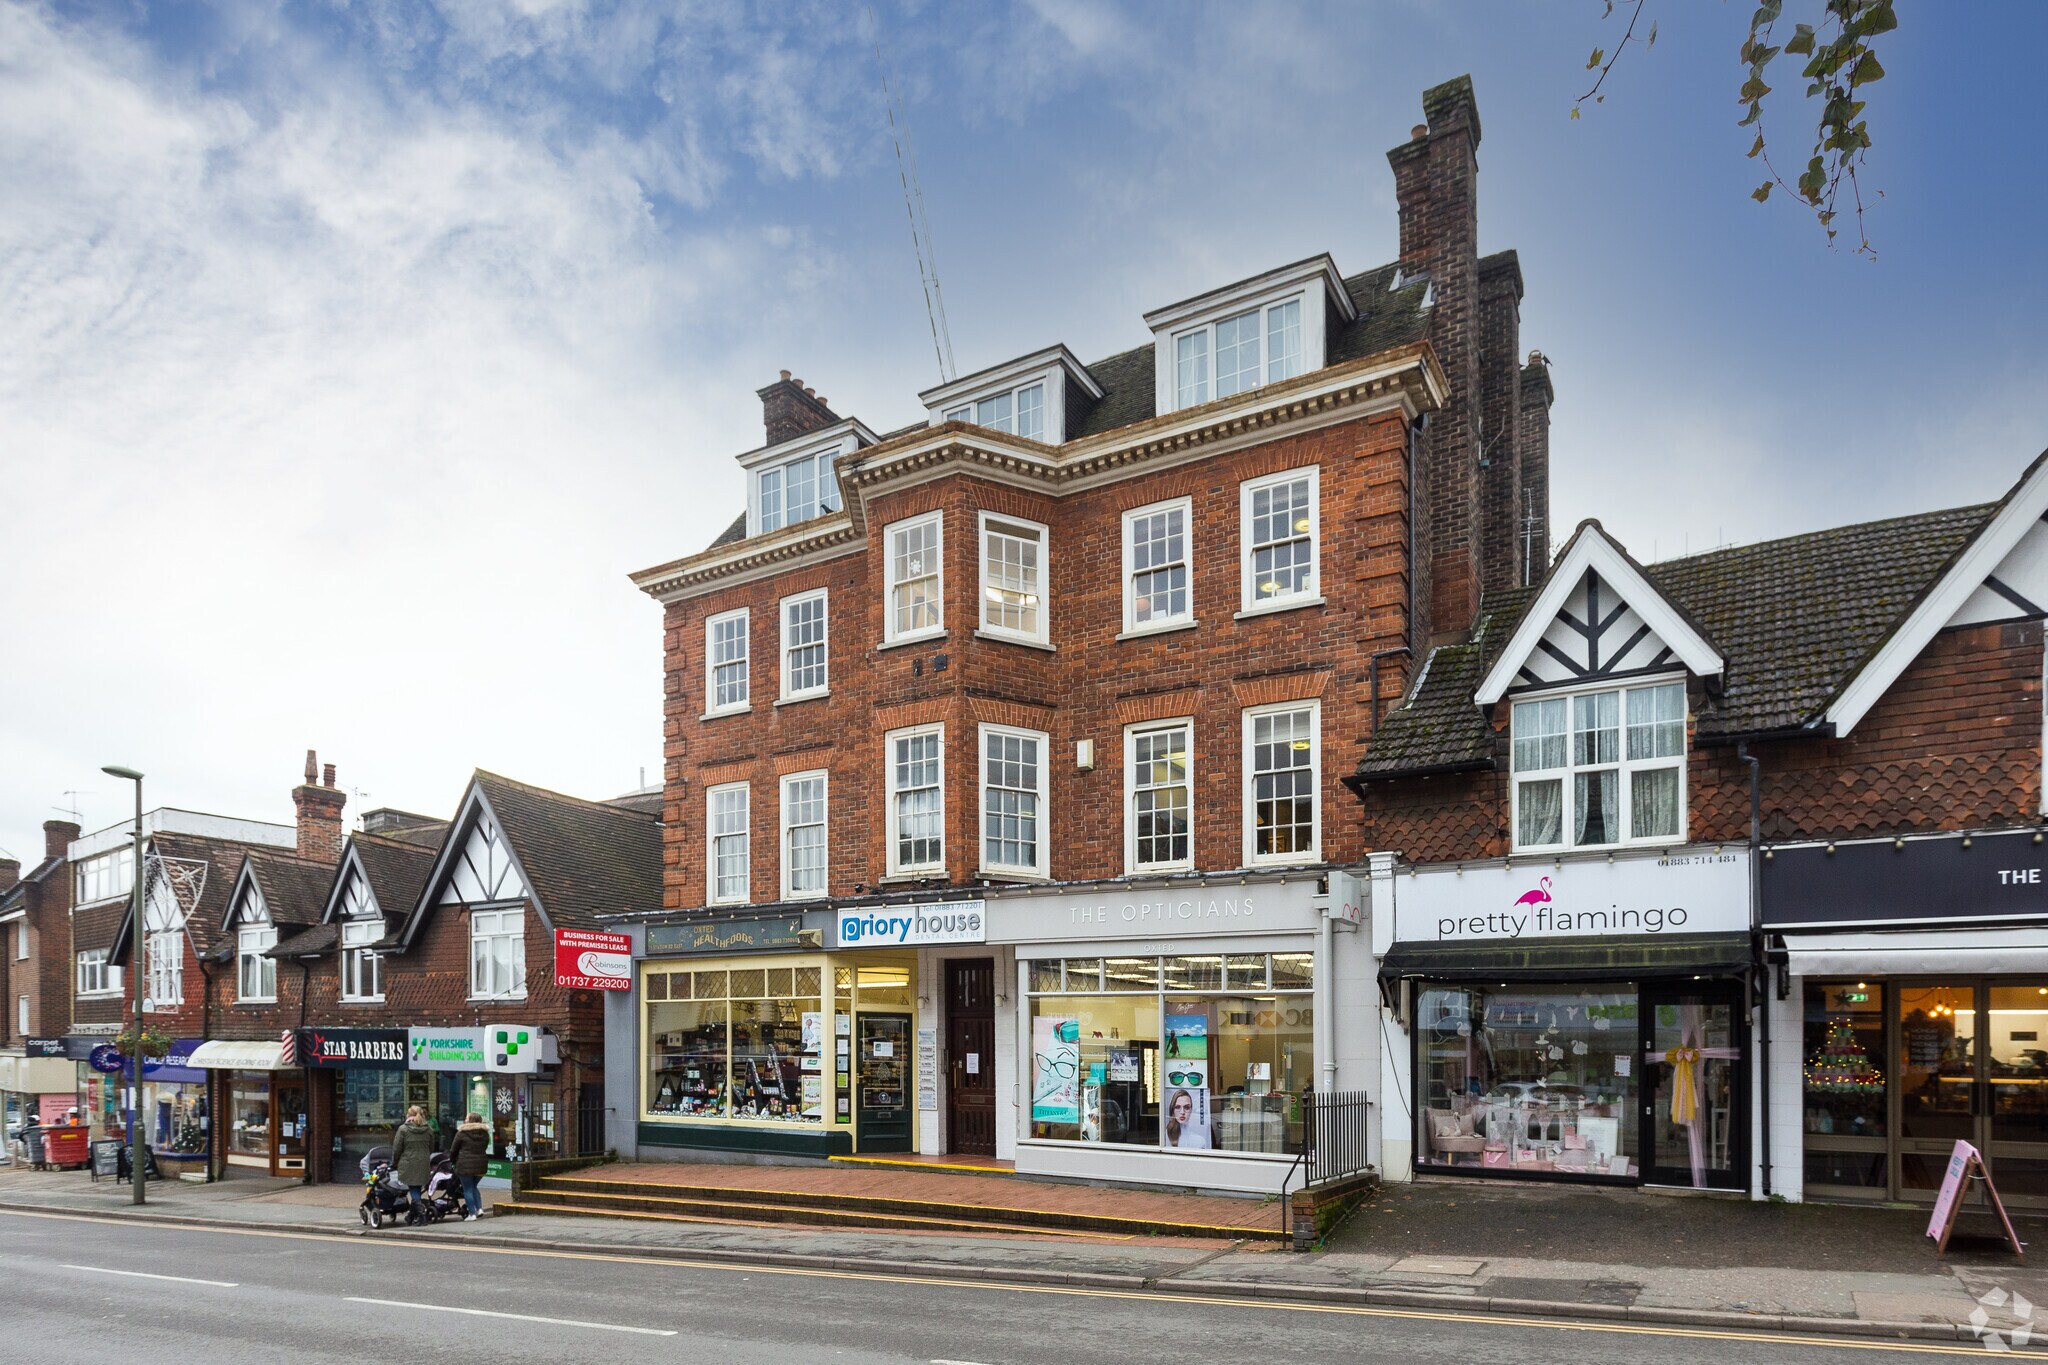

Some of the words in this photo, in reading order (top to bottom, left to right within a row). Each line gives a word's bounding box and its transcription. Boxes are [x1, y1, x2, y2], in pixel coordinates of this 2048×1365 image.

[1658, 858, 1690, 866] 01883
[1998, 869, 2041, 884] THE
[1070, 906, 1107, 923] THE
[1122, 898, 1254, 922] OPTICIANS
[1438, 912, 1527, 940] pretty
[1536, 905, 1688, 932] flamingo
[694, 925, 714, 933] OXTED
[564, 932, 594, 940] BUSINESS
[578, 941, 608, 950] PREMISES
[1144, 944, 1175, 952] OXTED
[582, 953, 628, 974] Robinsons
[558, 976, 590, 986] 01737
[592, 978, 628, 988] 229200
[28, 1040, 59, 1048] carpet
[430, 1039, 473, 1048] YORKSHIRE
[324, 1041, 347, 1056] STAR
[350, 1041, 404, 1060] BARBERS
[428, 1051, 464, 1060] BUILDING
[466, 1051, 484, 1060] SOCI
